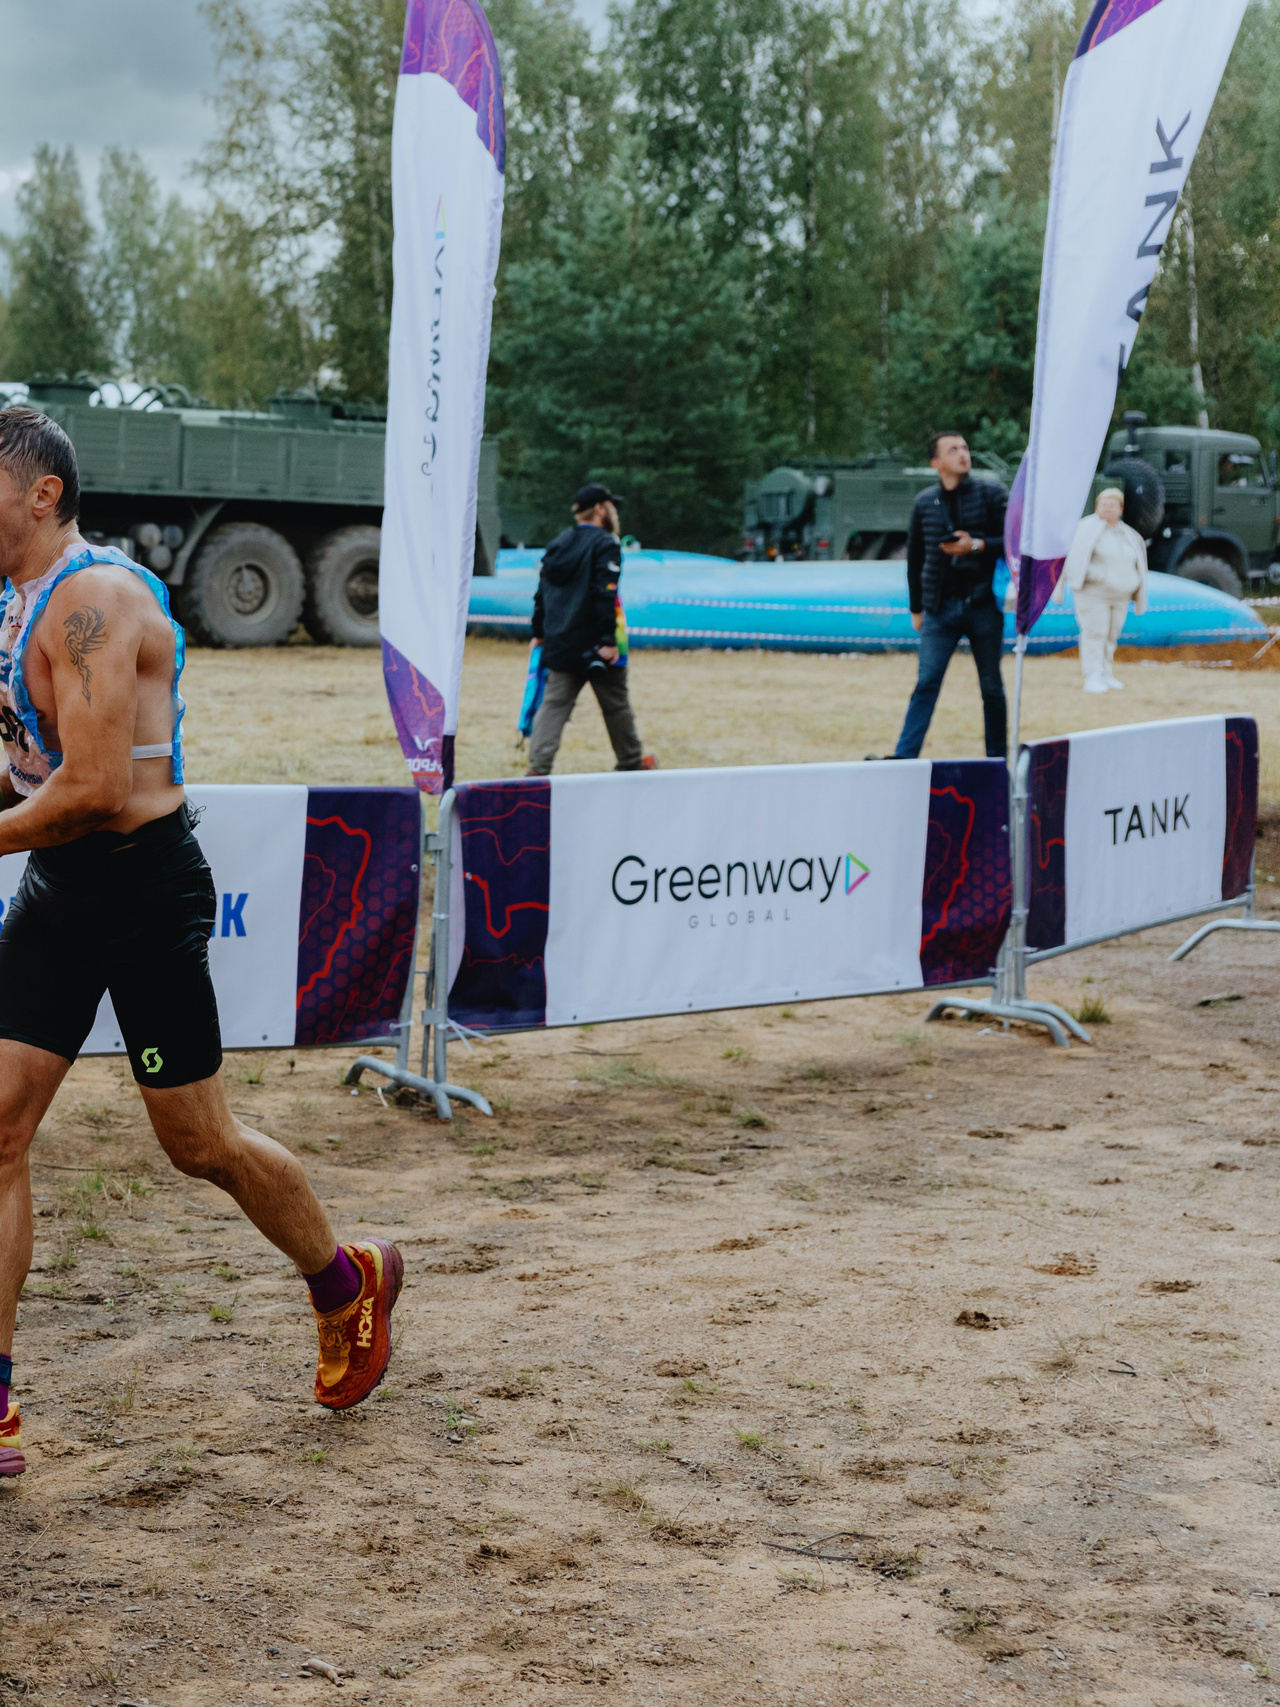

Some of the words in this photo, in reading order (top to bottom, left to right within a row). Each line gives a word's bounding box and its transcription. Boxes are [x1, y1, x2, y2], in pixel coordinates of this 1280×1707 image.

[1104, 793, 1190, 845] TANK
[611, 855, 842, 905] Greenway
[688, 908, 791, 929] GLOBAL
[356, 1296, 375, 1348] HOKA
